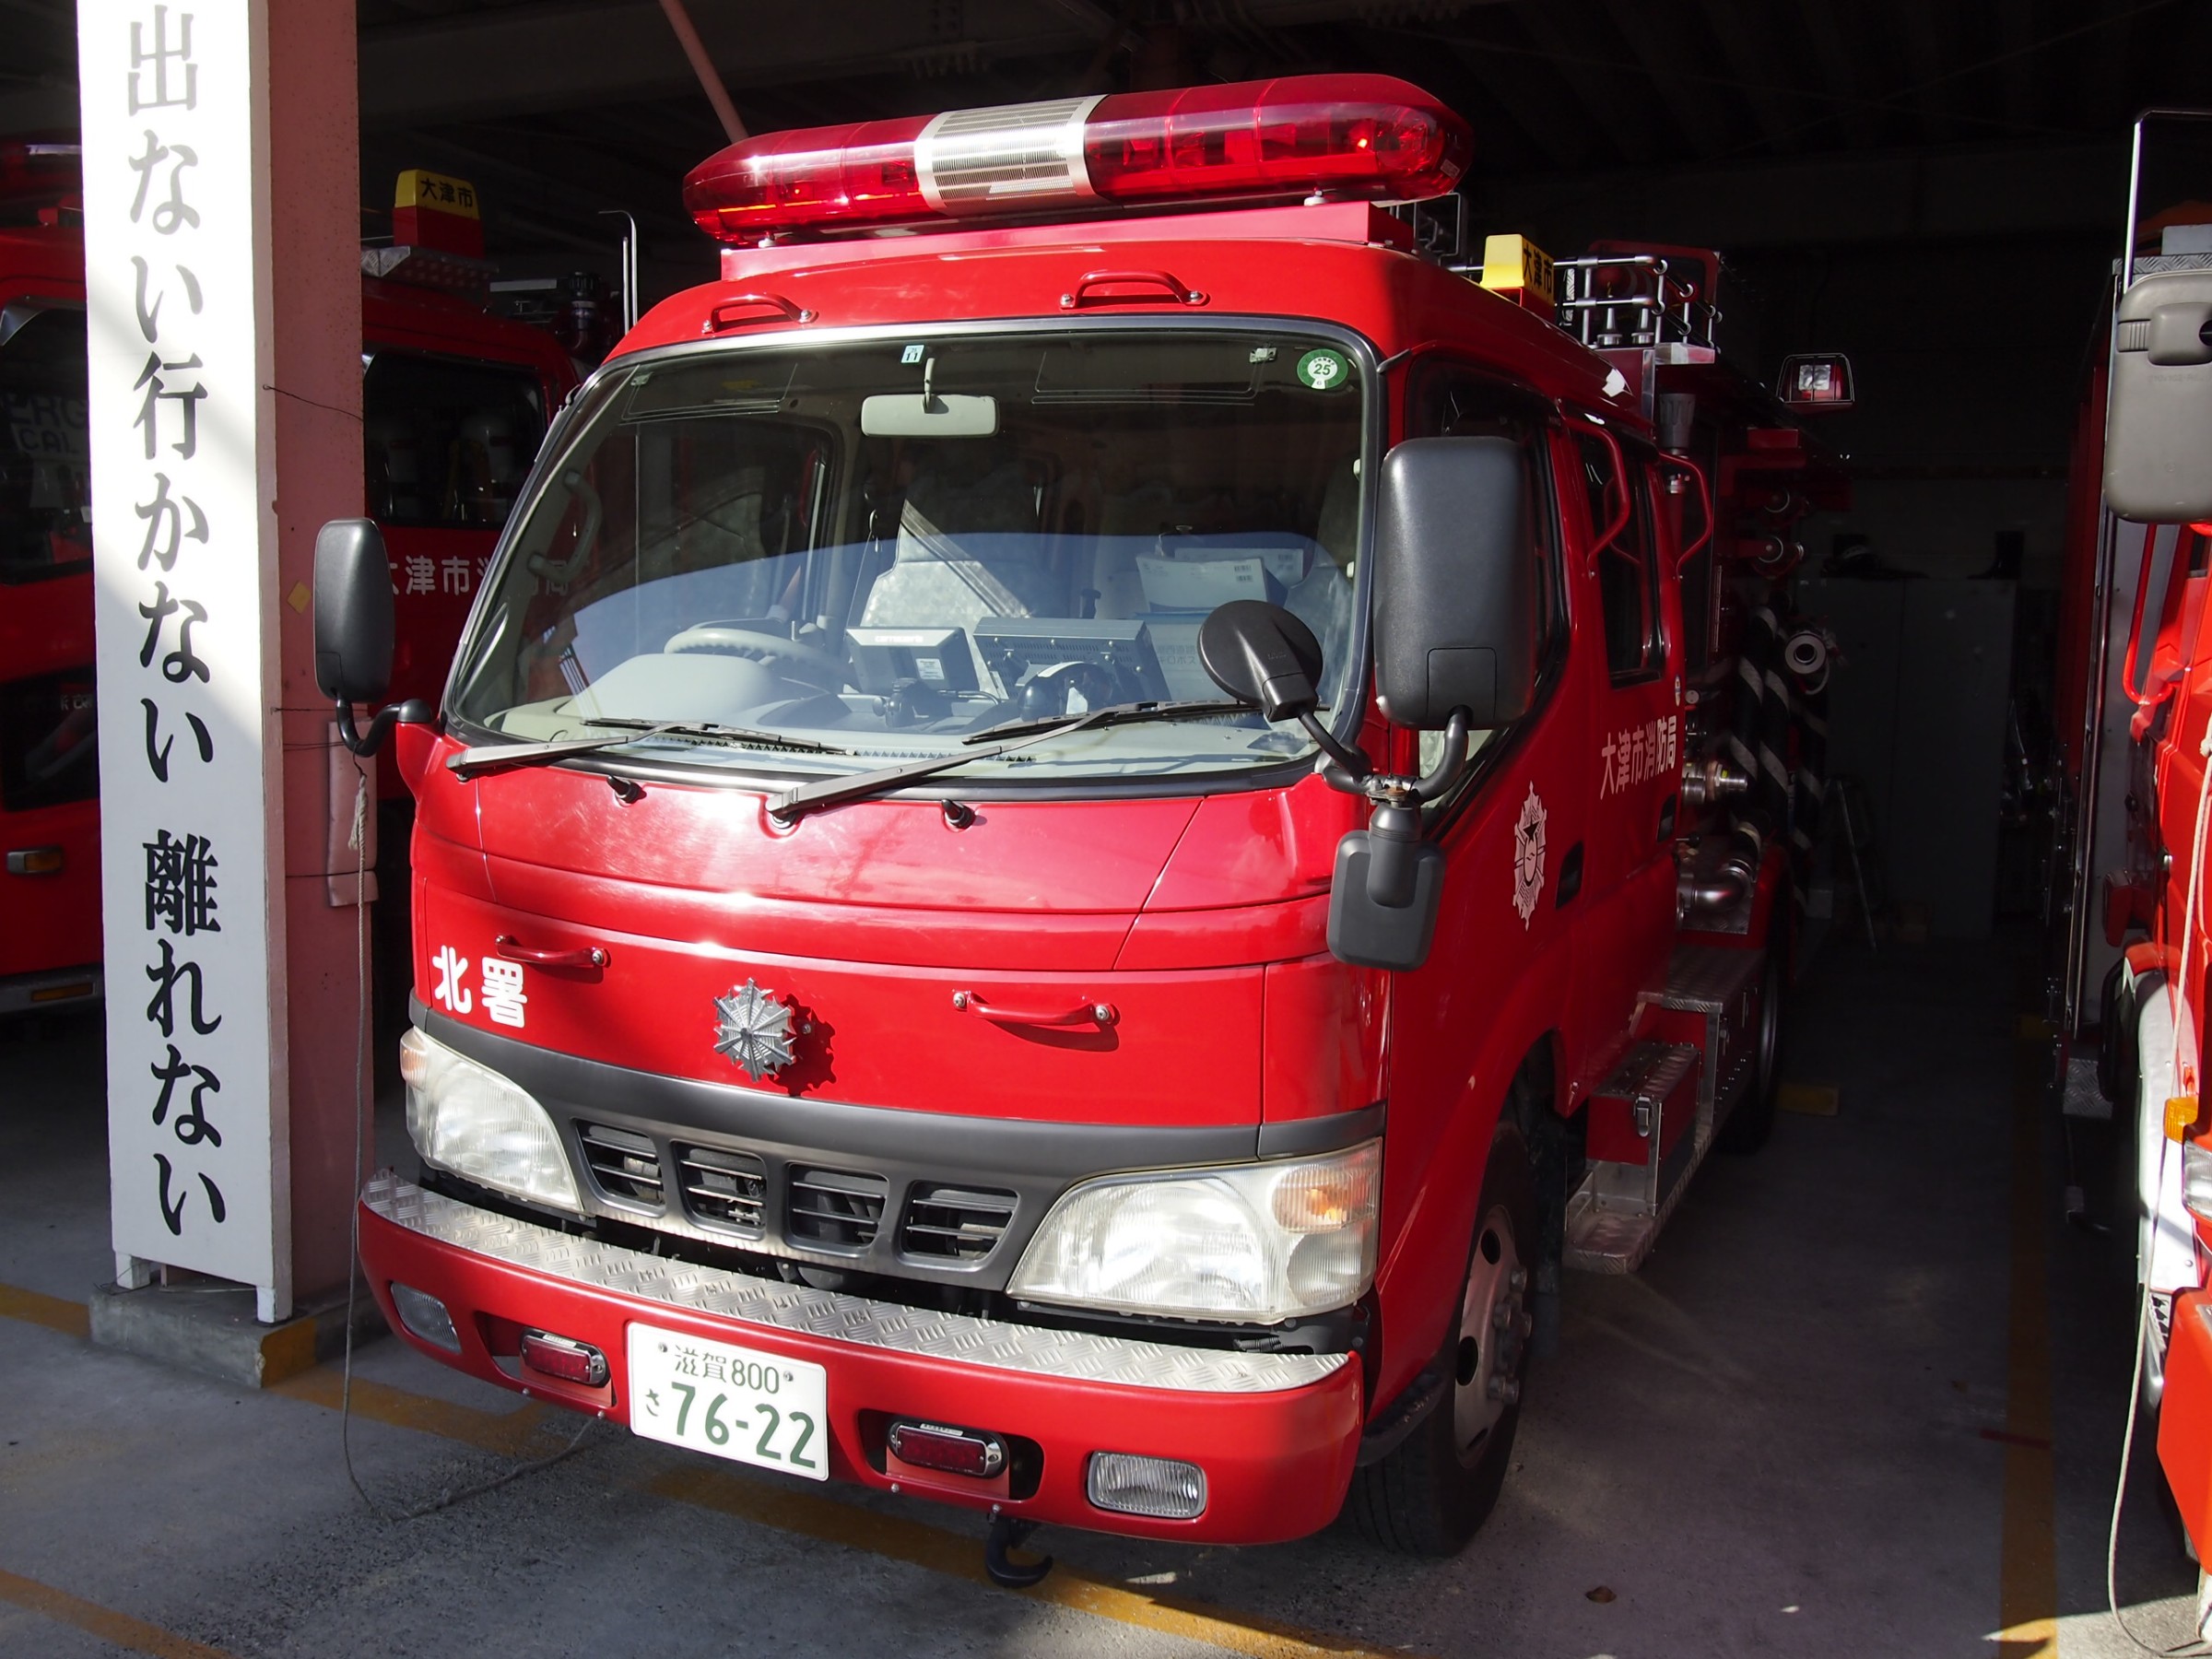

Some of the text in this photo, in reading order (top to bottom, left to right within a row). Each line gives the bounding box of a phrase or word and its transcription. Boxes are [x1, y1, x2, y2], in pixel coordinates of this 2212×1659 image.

[420, 177, 474, 208] 大津市
[1523, 241, 1553, 294] 大津市
[1313, 363, 1331, 375] 25
[1600, 714, 1677, 800] 大津市消防局
[431, 945, 528, 1029] 北署
[142, 829, 227, 1236] 離れない
[645, 1381, 816, 1469] さ 76-22
